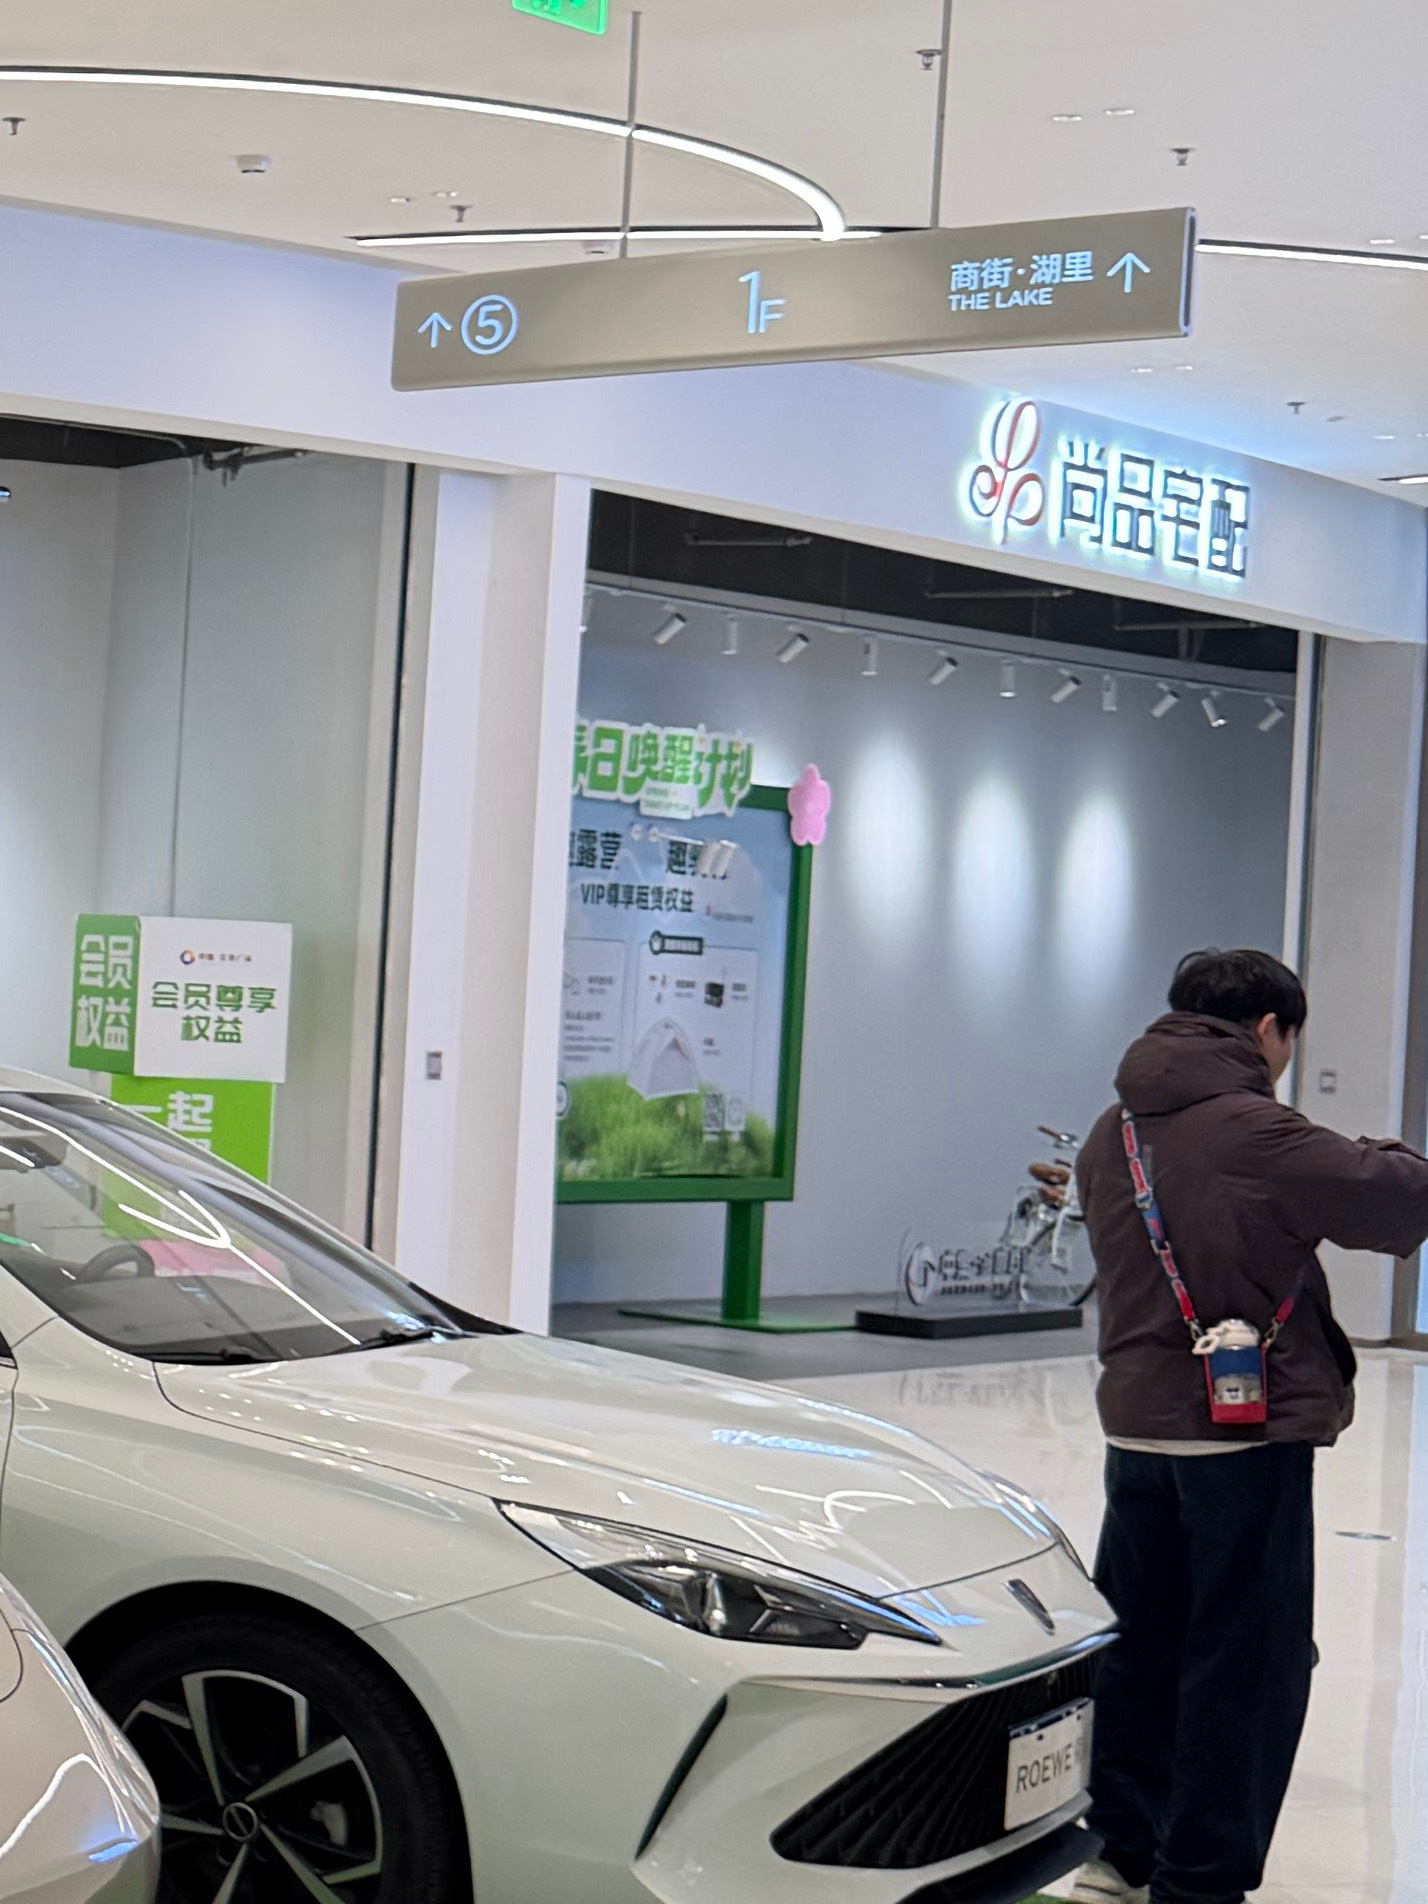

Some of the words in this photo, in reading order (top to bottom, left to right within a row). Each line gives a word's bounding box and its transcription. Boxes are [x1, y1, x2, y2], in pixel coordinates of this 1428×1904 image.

[950, 251, 1095, 291] 商街·湖里
[738, 270, 787, 334] 1F
[948, 293, 990, 311] THE
[995, 287, 1053, 309] LAKE
[79, 934, 134, 990] 会员
[151, 981, 277, 1014] 会员尊享
[75, 994, 130, 1052] 权益
[180, 1015, 243, 1044] 权益
[1015, 1742, 1073, 1794] ROEWE
